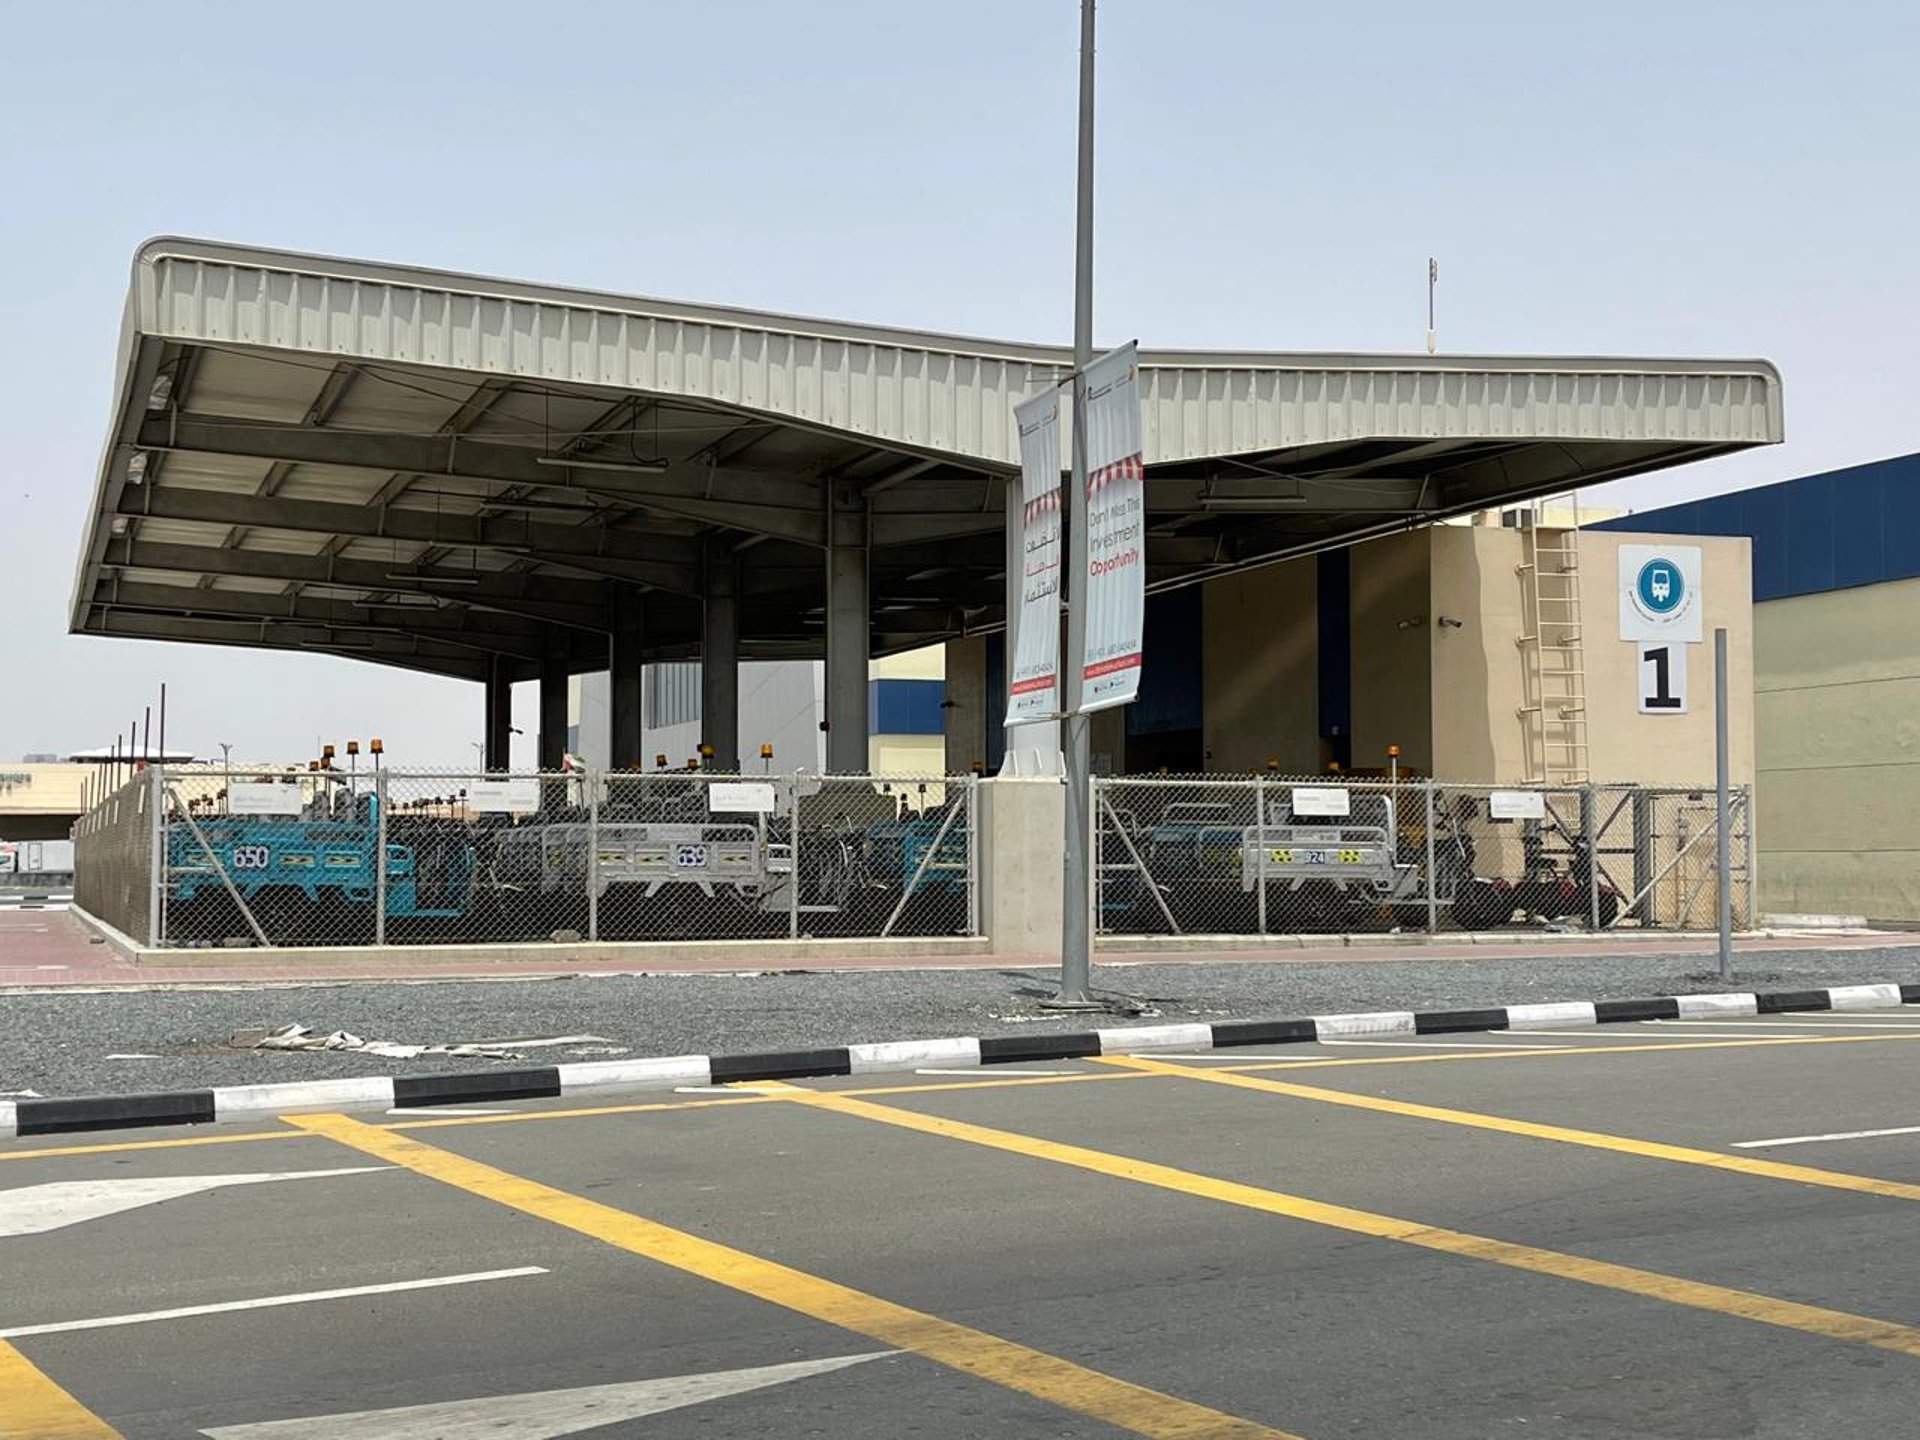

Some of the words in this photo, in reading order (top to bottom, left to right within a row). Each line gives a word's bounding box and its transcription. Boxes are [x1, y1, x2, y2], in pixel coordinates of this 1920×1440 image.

[1090, 521, 1140, 552] Investment
[1090, 547, 1140, 577] Opportunity
[1643, 647, 1682, 708] 1
[234, 845, 269, 868] 650
